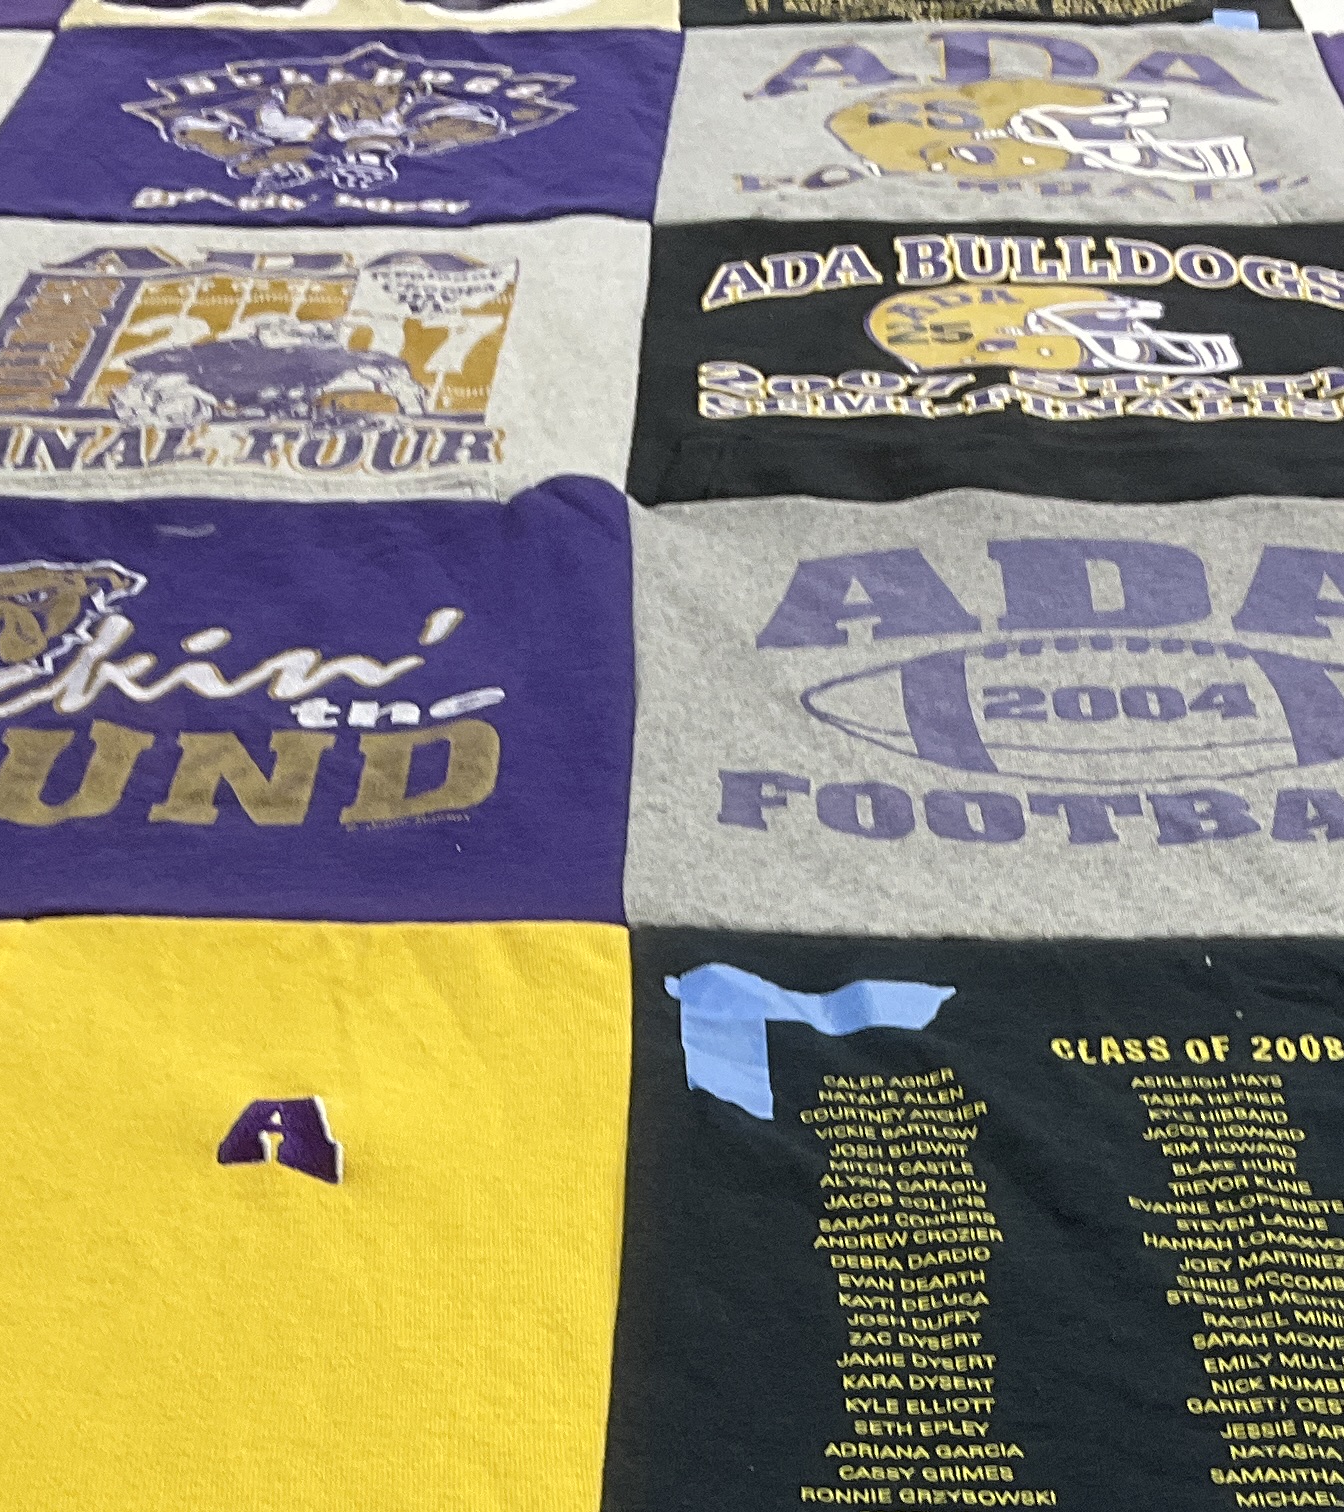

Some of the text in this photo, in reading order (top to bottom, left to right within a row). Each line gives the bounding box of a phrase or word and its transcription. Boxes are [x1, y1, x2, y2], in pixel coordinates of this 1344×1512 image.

[743, 31, 1280, 101] ADA
[702, 244, 882, 310] ADA
[235, 427, 505, 477] FOUR
[982, 683, 1256, 723] 2004
[1050, 1035, 1171, 1065] CLASS
[1184, 1034, 1230, 1064] OF
[819, 1086, 964, 1105] NATALIE ALLEN
[800, 1106, 906, 1124] COURTNEY
[217, 1094, 344, 1185] A
[1214, 1124, 1305, 1142] HOWARD
[830, 1144, 883, 1158] JOSH
[1162, 1141, 1297, 1158] KIM HOWARD
[1242, 1158, 1297, 1175] HUNT
[1167, 1174, 1249, 1196] TREVOR
[824, 1192, 893, 1211] JACOB
[819, 1213, 889, 1232] SARAH
[1176, 1215, 1255, 1232] STEVEN
[814, 1231, 908, 1249] ANDREW
[1142, 1232, 1233, 1251] HANNAH
[830, 1254, 904, 1271] DEBRA
[1179, 1256, 1233, 1272] JOEY
[838, 1269, 985, 1292] EVAN DEARTH
[847, 1311, 981, 1330] JOSH DUFFY
[1203, 1311, 1289, 1328] RACHEL
[1192, 1332, 1269, 1350] SARAH
[836, 1353, 906, 1368] JAMIE
[1203, 1352, 1272, 1373] EMILY
[843, 1373, 904, 1391] KARA
[1211, 1376, 1266, 1394] NICK
[846, 1397, 995, 1415] KYLE ELLIOTT
[1186, 1396, 1290, 1414] GARRETT
[855, 1420, 990, 1437] SETH EPLEY
[824, 1442, 1024, 1459] ADRIANA GARCIA
[1229, 1443, 1343, 1462] NATASHA
[922, 1465, 1015, 1482] GRIMES
[800, 1486, 1057, 1506] RONNIE GRZYBOWSKI
